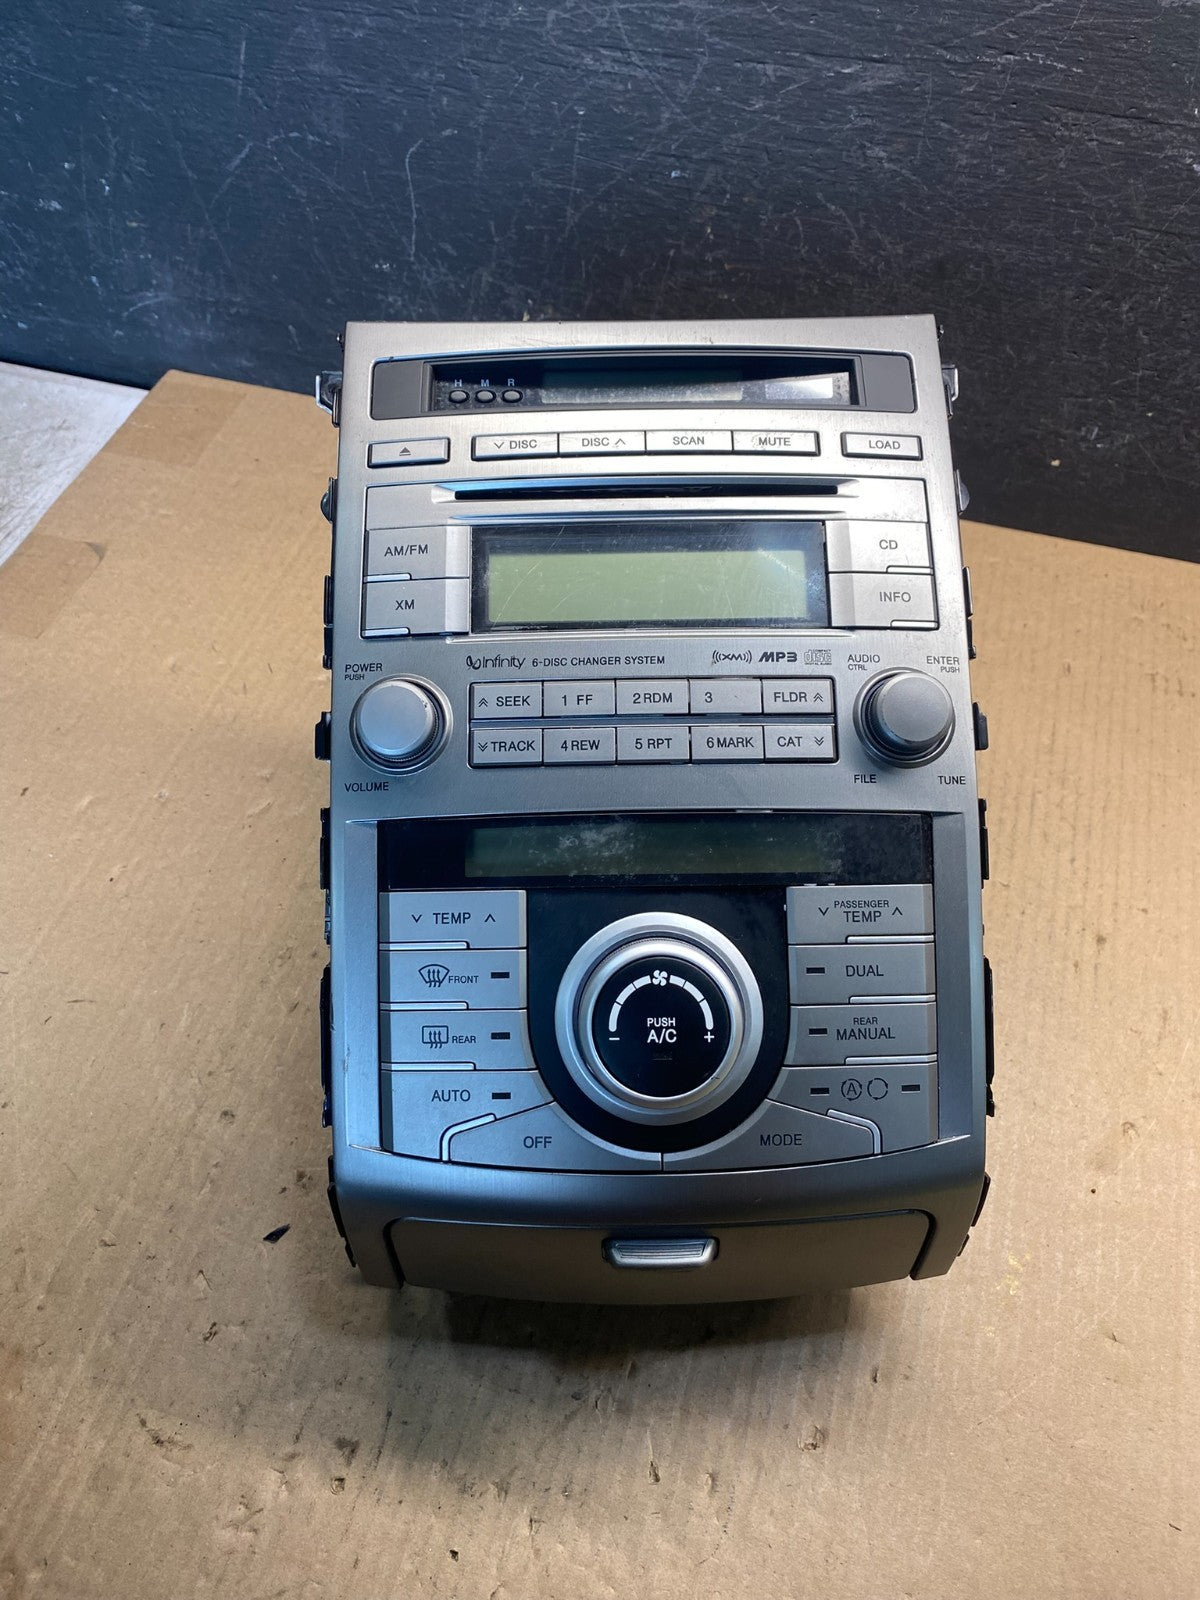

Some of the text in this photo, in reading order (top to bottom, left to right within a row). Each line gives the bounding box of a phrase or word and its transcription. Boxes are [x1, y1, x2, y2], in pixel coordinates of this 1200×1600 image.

[454, 379, 463, 387] H
[480, 379, 490, 387] M
[507, 378, 515, 387] R
[509, 439, 538, 450] DISC
[581, 437, 610, 448] DISC
[672, 436, 705, 446] SCAN
[758, 436, 792, 447] MUTE
[868, 440, 901, 450] LOAD
[384, 544, 429, 556] AM/FM
[879, 539, 898, 550] CD
[879, 591, 912, 602] INFO
[395, 600, 415, 611] XM
[532, 657, 568, 667] 6-DISC
[570, 656, 621, 666] CHANGER
[624, 656, 665, 665] SYSTEM
[758, 651, 798, 662] MP3
[847, 654, 880, 664] AUDIO
[926, 656, 960, 665] ENTER
[344, 663, 383, 673] POWER
[496, 695, 531, 707] SEEK
[561, 694, 593, 706] 1 FF
[632, 692, 673, 704] 2 RDM
[704, 692, 713, 703] 3
[773, 692, 808, 703] FLDR
[491, 740, 536, 752] TRACK
[561, 740, 600, 751] 4 REW
[635, 738, 672, 749] 5 RPT
[706, 737, 755, 748] 6 MARK
[777, 736, 802, 748] CAT
[853, 774, 877, 784] FILE
[937, 775, 966, 785] TUNE
[344, 781, 390, 792] VOLUME
[834, 900, 890, 909] PASSENGER
[432, 912, 472, 925] TEMP
[843, 910, 883, 923] TEMP
[845, 964, 884, 977] DUAL
[448, 974, 479, 984] FRONT
[646, 1017, 676, 1027] PUSH
[853, 1017, 878, 1026] REAR
[451, 1034, 477, 1044] REAR
[646, 1028, 678, 1044] A/C
[836, 1027, 896, 1041] MANUAL
[431, 1089, 471, 1102] AUTO
[523, 1136, 552, 1149] OFF
[760, 1133, 803, 1146] MODE
